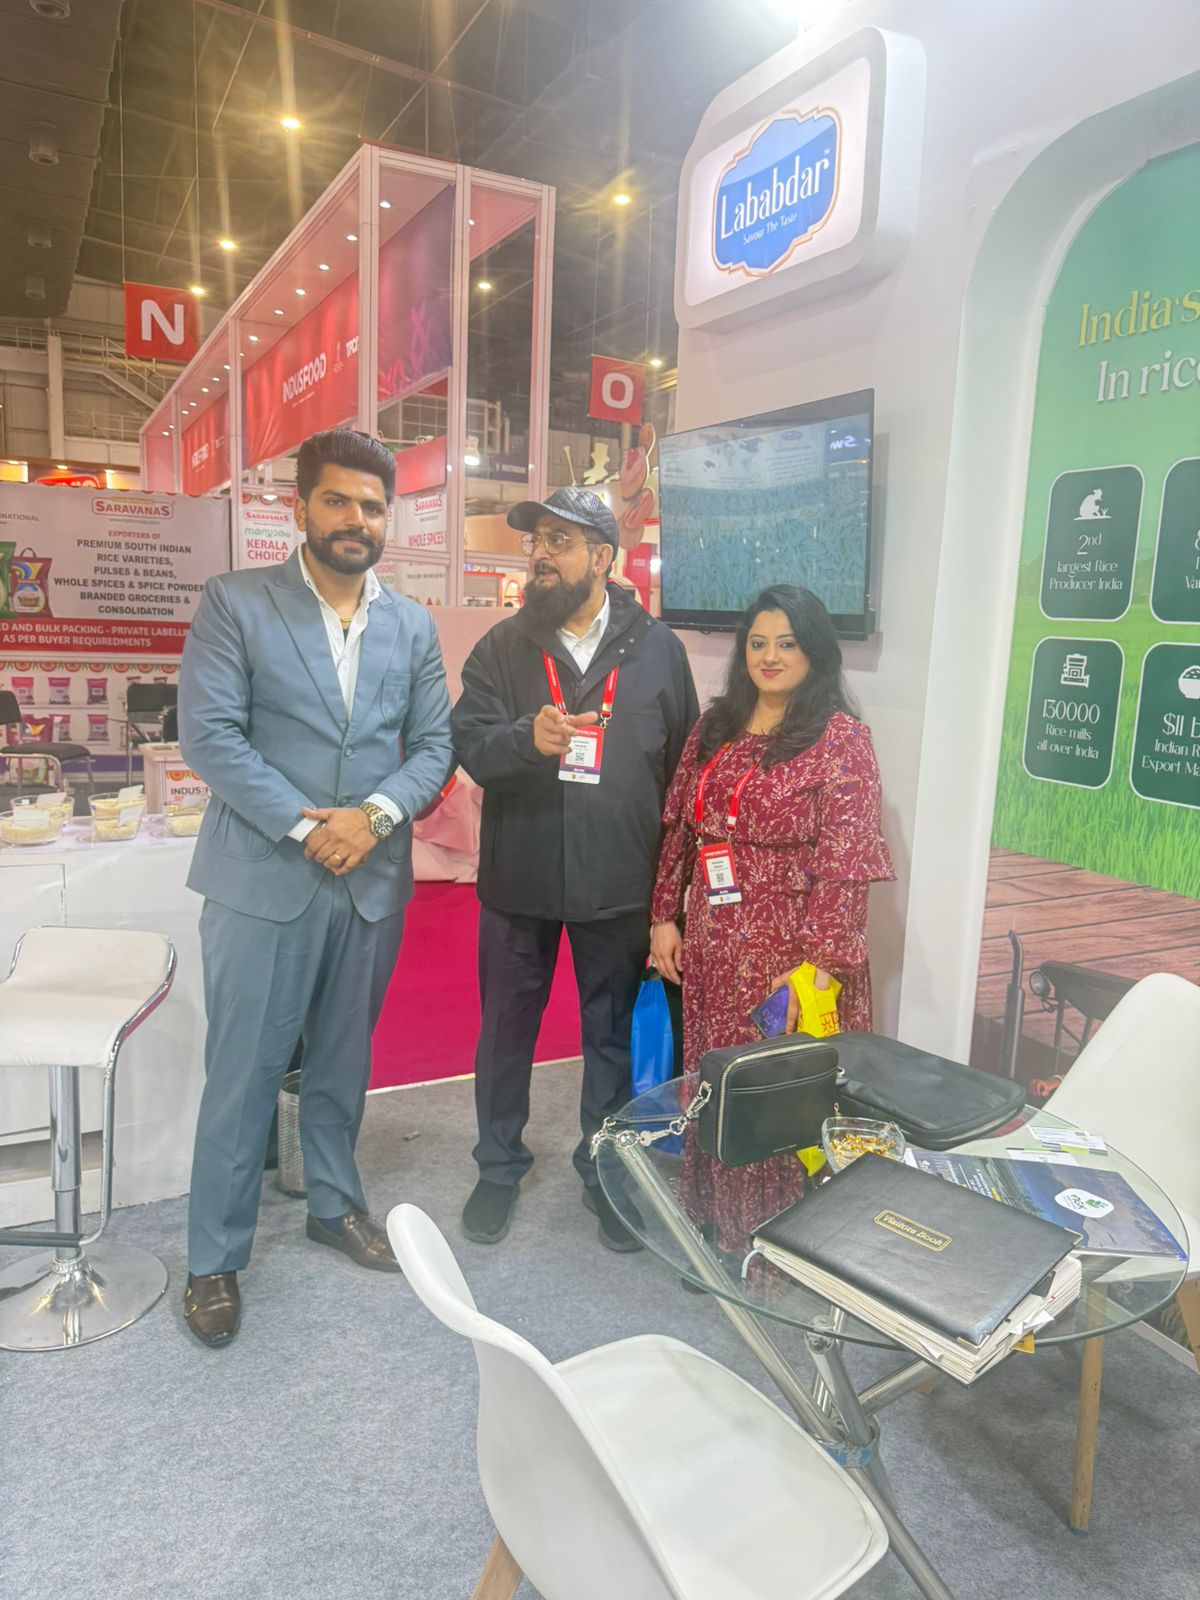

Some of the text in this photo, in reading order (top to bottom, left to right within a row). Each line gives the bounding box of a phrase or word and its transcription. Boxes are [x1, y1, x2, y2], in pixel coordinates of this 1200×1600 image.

[766, 221, 779, 234] The
[780, 213, 798, 227] Taste
[141, 299, 185, 346] N
[1097, 360, 1130, 402] In
[602, 372, 634, 409] O
[108, 530, 150, 539] EXPORTERS
[77, 539, 192, 554] PREMIUM SOUTH INDIAN
[247, 538, 289, 551] KERALA
[97, 553, 173, 567] RICE VARIETIES,
[247, 550, 289, 561] CHOICE
[94, 566, 177, 579] PULSES & BEANS,
[1095, 560, 1118, 573] Rice
[54, 577, 89, 587] WHOLE
[91, 578, 126, 589] SPICES
[128, 580, 135, 589] &
[137, 580, 165, 591] SPICE
[1049, 577, 1123, 590] Producer India
[80, 591, 191, 604] BRANDED GROCERIES &
[98, 605, 174, 616] CONSOLIDATION
[12, 622, 33, 632] AND
[35, 623, 60, 633] BULK
[62, 624, 104, 635] PACKING
[111, 626, 150, 636] PRIVATE
[3, 634, 152, 647] AS PER BUYER REQUIREDMENTS
[1042, 698, 1100, 725] 130000
[1045, 723, 1092, 741] Rice mills
[1037, 739, 1099, 759] all over India
[1154, 739, 1189, 756] Indian
[1142, 755, 1181, 773] Export
